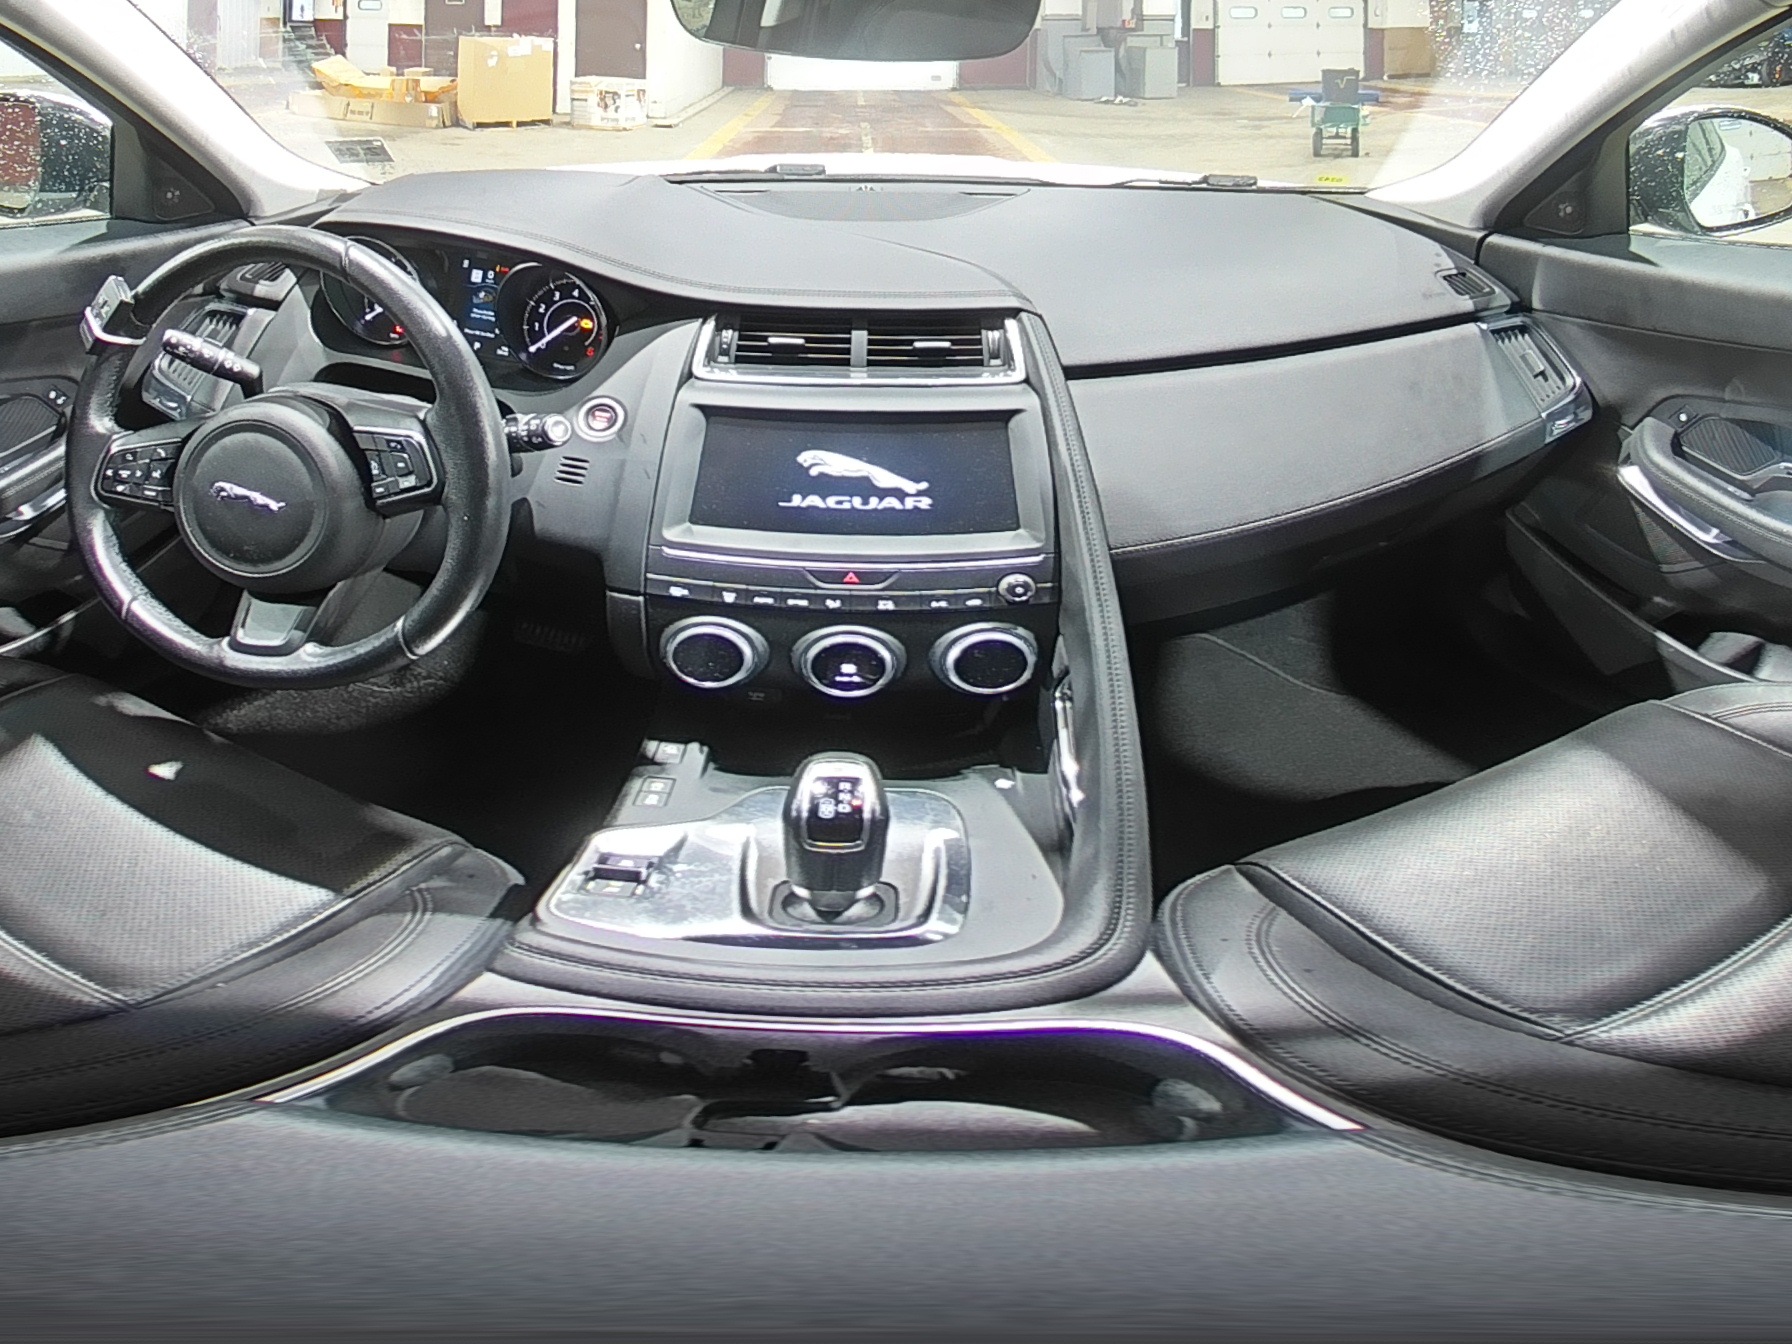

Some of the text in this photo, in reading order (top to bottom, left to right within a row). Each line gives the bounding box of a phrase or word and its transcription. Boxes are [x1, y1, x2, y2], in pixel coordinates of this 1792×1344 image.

[553, 289, 579, 301] 3 4
[538, 303, 546, 313] 2
[778, 494, 933, 510] JAGUAR
